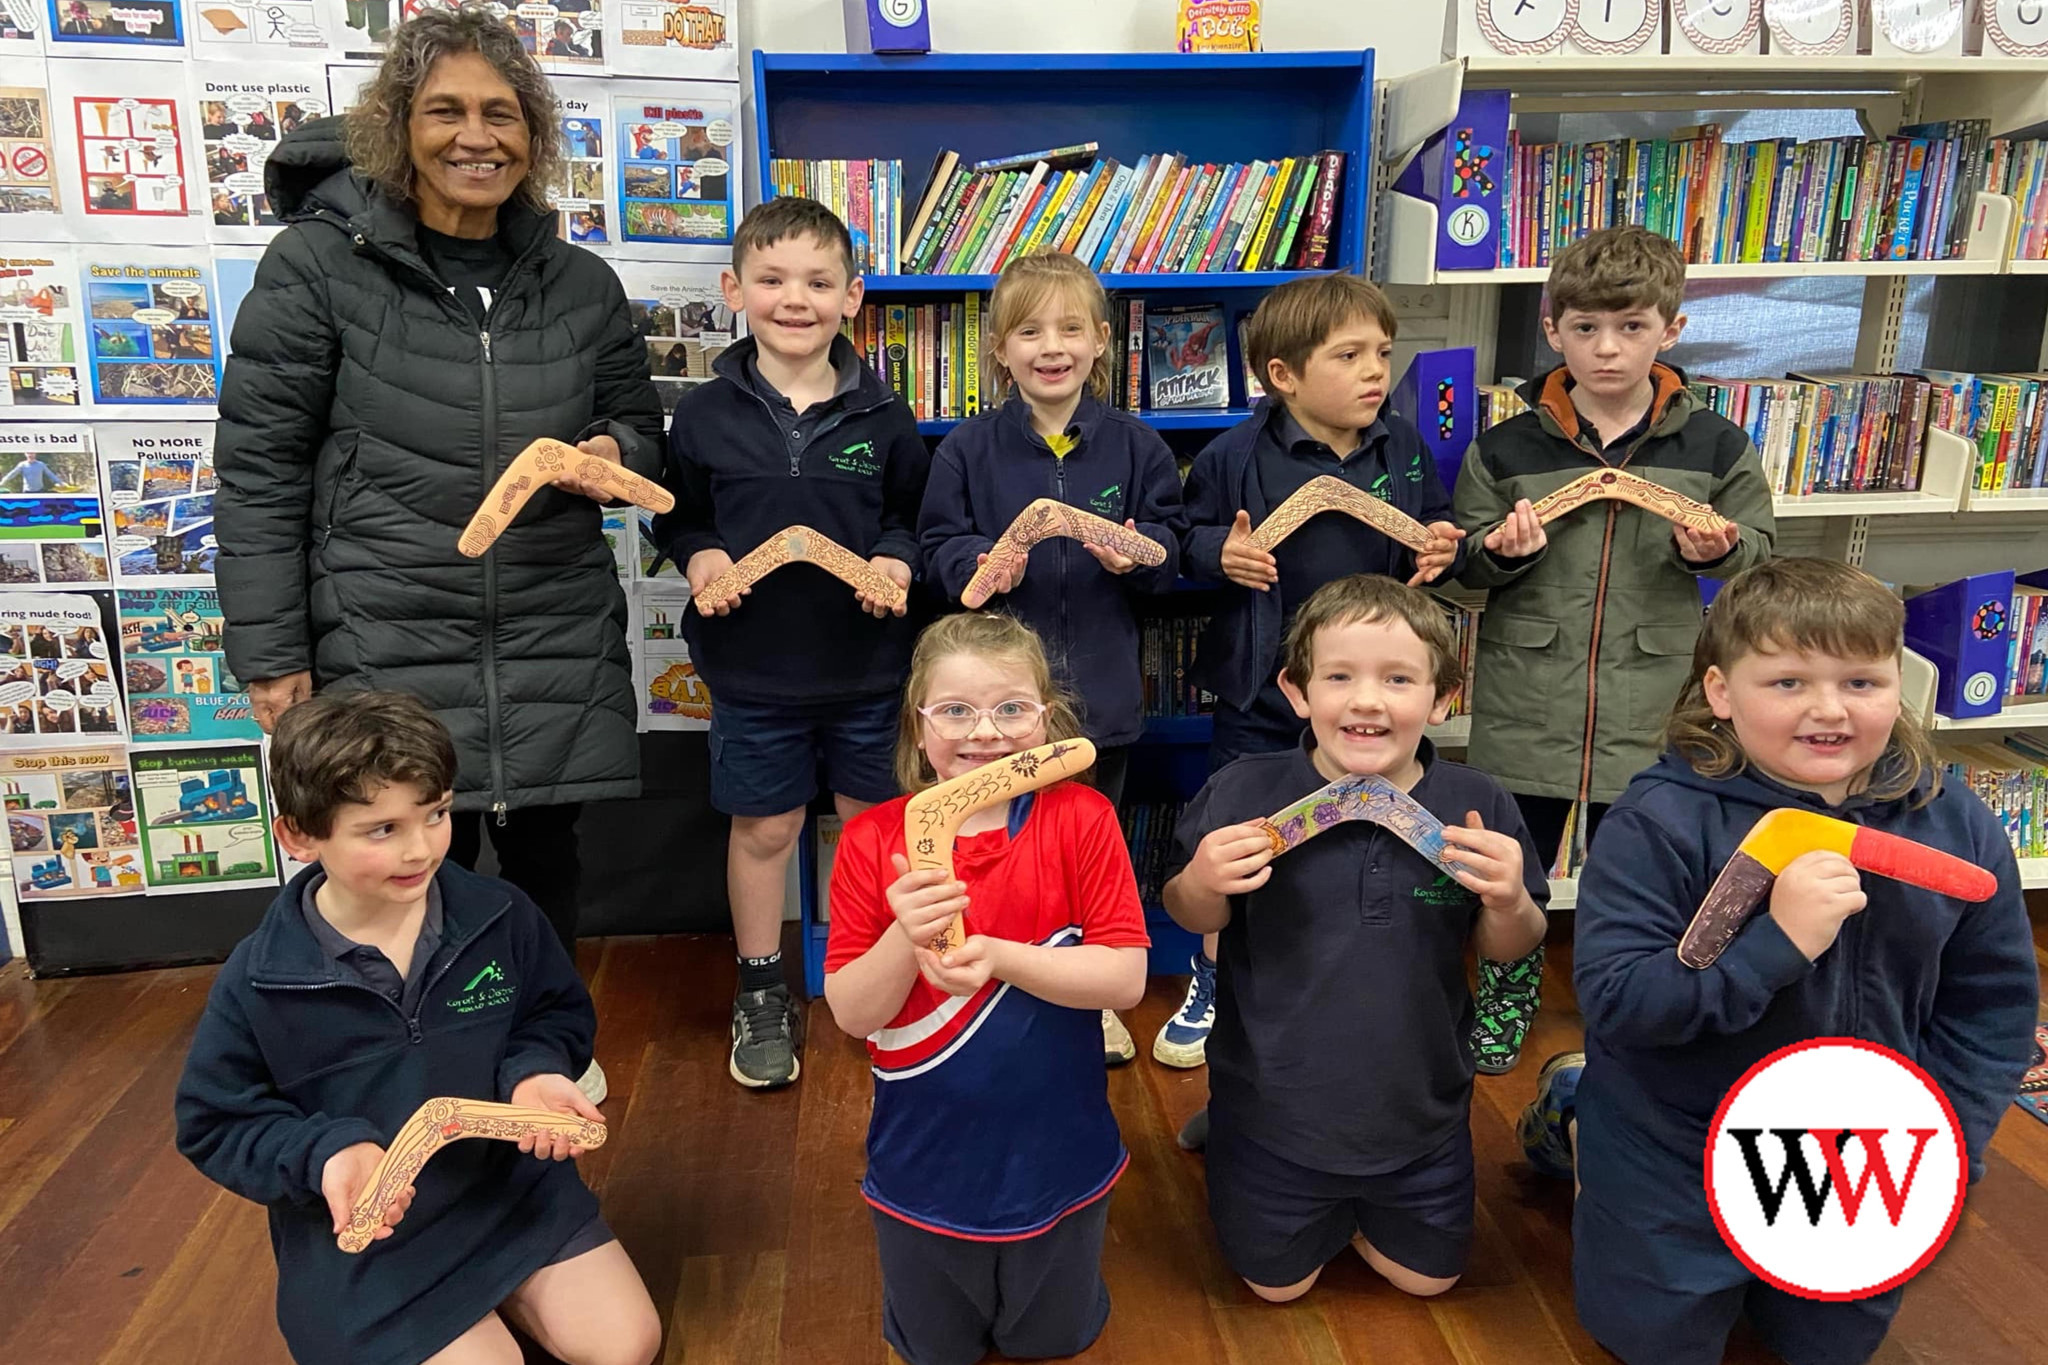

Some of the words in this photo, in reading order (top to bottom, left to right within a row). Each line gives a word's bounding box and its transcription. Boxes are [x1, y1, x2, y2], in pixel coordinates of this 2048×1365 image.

[1188, 4, 1227, 20] Definitely
[663, 12, 685, 40] DO
[685, 10, 726, 44] THAT!
[1202, 16, 1246, 39] DOG
[206, 82, 238, 92] Dont
[242, 83, 264, 92] use
[268, 83, 311, 95] plastic
[567, 101, 588, 112] day
[1452, 128, 1496, 198] K
[1111, 174, 1127, 196] Once
[1321, 154, 1339, 233] DEADLY!
[1097, 201, 1114, 223] Then
[1896, 190, 1917, 245] POCKET
[90, 265, 121, 278] Save
[125, 266, 145, 278] the
[149, 267, 200, 278] animals
[650, 284, 668, 292] Save
[669, 284, 680, 292] the
[969, 313, 977, 358] theodore
[969, 362, 977, 390] boone
[1155, 366, 1222, 401] ATTACK
[34, 433, 46, 443] is
[50, 434, 77, 443] bad
[132, 438, 155, 448] NO
[160, 438, 203, 448] MORE
[137, 451, 202, 461] Pollution!
[30, 610, 60, 618] nude
[63, 610, 92, 620] food!
[1972, 599, 2006, 641] O
[196, 696, 224, 706] BLUE
[13, 756, 46, 769] Stop
[50, 757, 76, 767] this
[80, 755, 110, 765] now
[138, 758, 163, 769] Stop
